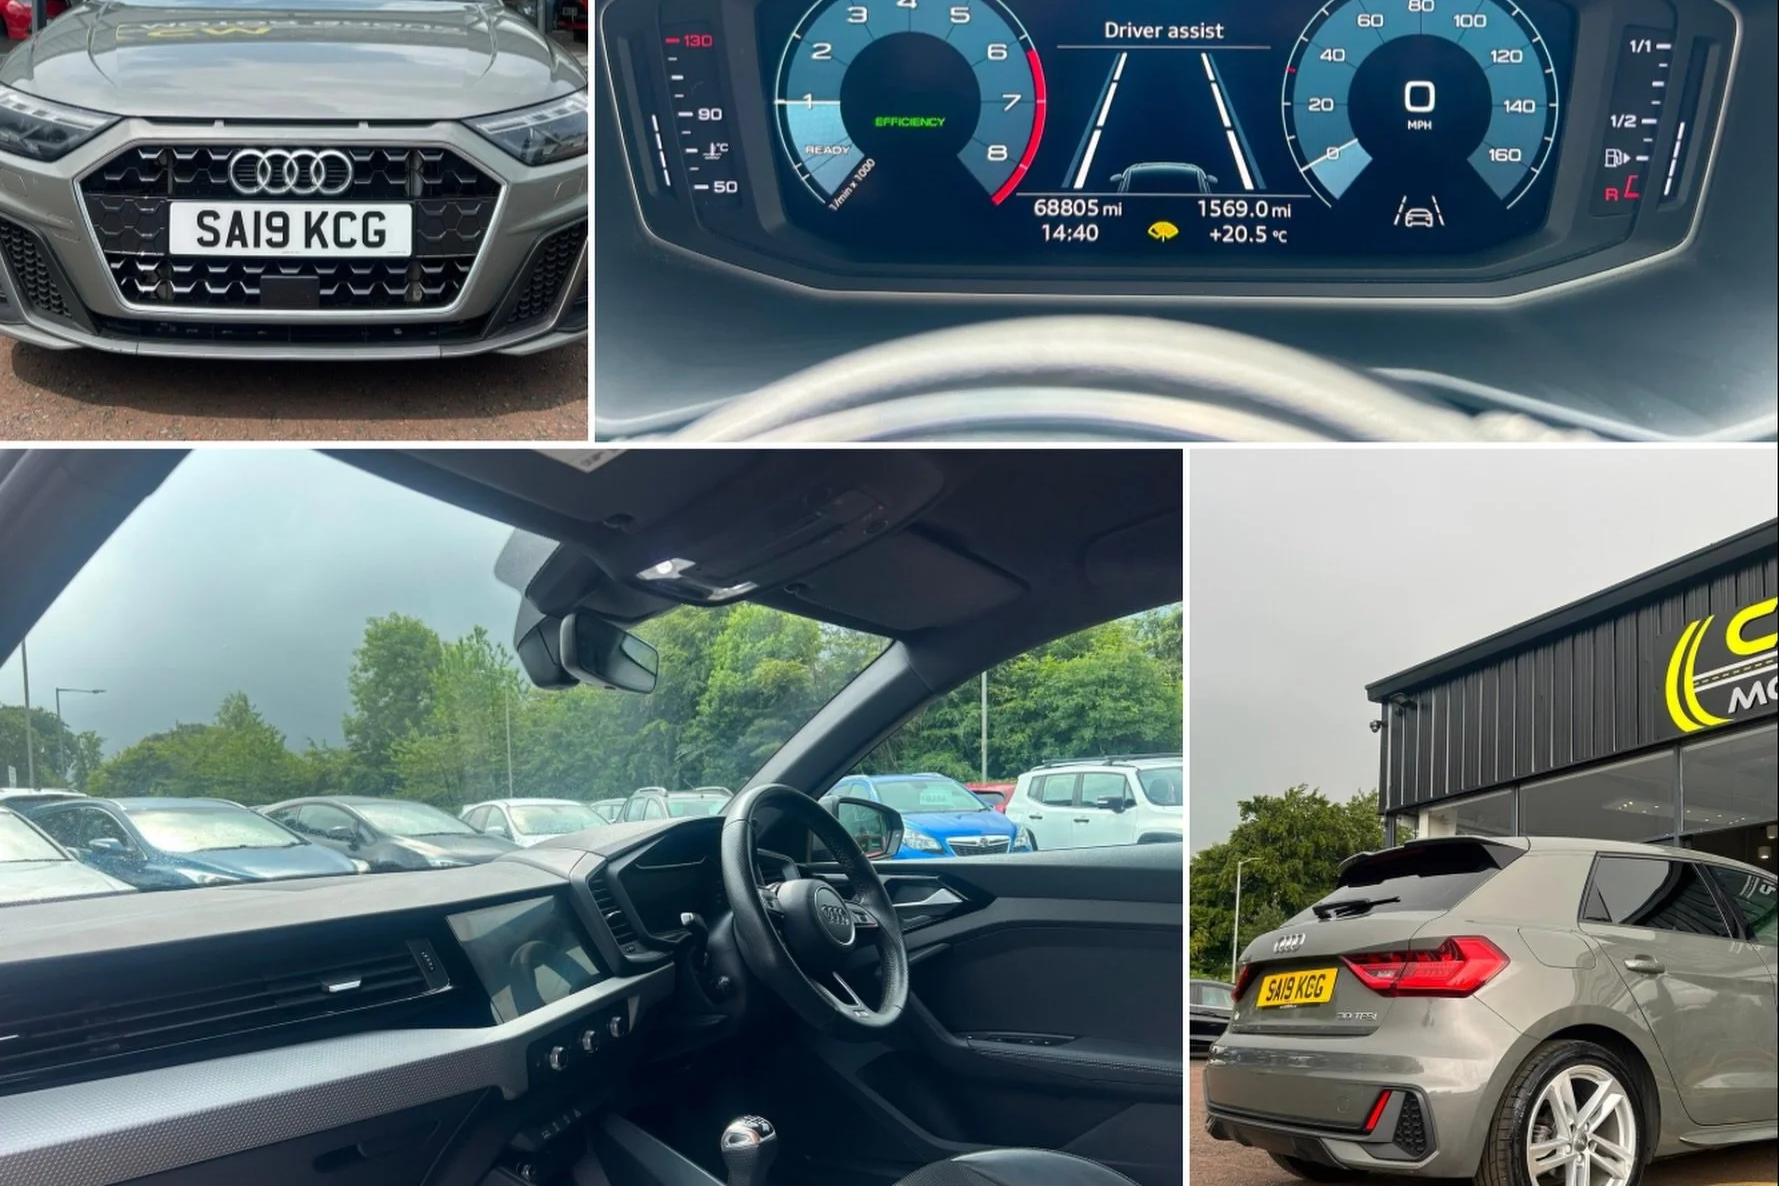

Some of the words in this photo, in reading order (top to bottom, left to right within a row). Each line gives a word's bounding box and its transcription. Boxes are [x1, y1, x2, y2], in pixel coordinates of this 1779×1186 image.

[846, 6, 868, 23] 3
[949, 6, 971, 23] 5
[1357, 14, 1384, 28] 60
[1453, 14, 1487, 28] 100
[1104, 22, 1163, 39] Driver
[1168, 22, 1224, 39] assist
[684, 34, 713, 47] 130
[1630, 39, 1651, 53] 1/1
[812, 43, 832, 60] 2
[987, 44, 1008, 60] 6
[1319, 49, 1346, 62] 40
[1490, 50, 1523, 64] 120
[803, 94, 813, 109] 1
[1001, 94, 1022, 111] 7
[1404, 80, 1436, 112] 0
[1308, 98, 1334, 112] 20
[1503, 100, 1536, 113] 140
[698, 108, 723, 121] 90
[875, 116, 946, 128] EFFICIENCY
[1609, 114, 1637, 128] 1/2
[1407, 120, 1432, 131] MPH
[805, 145, 850, 155] READY
[987, 145, 1008, 161] 8
[1326, 147, 1340, 160] 0
[1488, 148, 1522, 162] 160
[713, 180, 738, 194] 50
[829, 186, 853, 211] 1/min
[854, 158, 876, 182] 1000
[1605, 187, 1619, 202] R
[1034, 199, 1100, 217] 68805
[1103, 202, 1122, 216] mi
[1198, 200, 1269, 217] 1569.0
[1272, 203, 1291, 218] mi
[197, 210, 290, 249] SA19
[304, 210, 387, 249] KCG
[1042, 224, 1099, 242] 14:40
[1210, 225, 1267, 243] +20.5
[1266, 976, 1296, 1001] SA19
